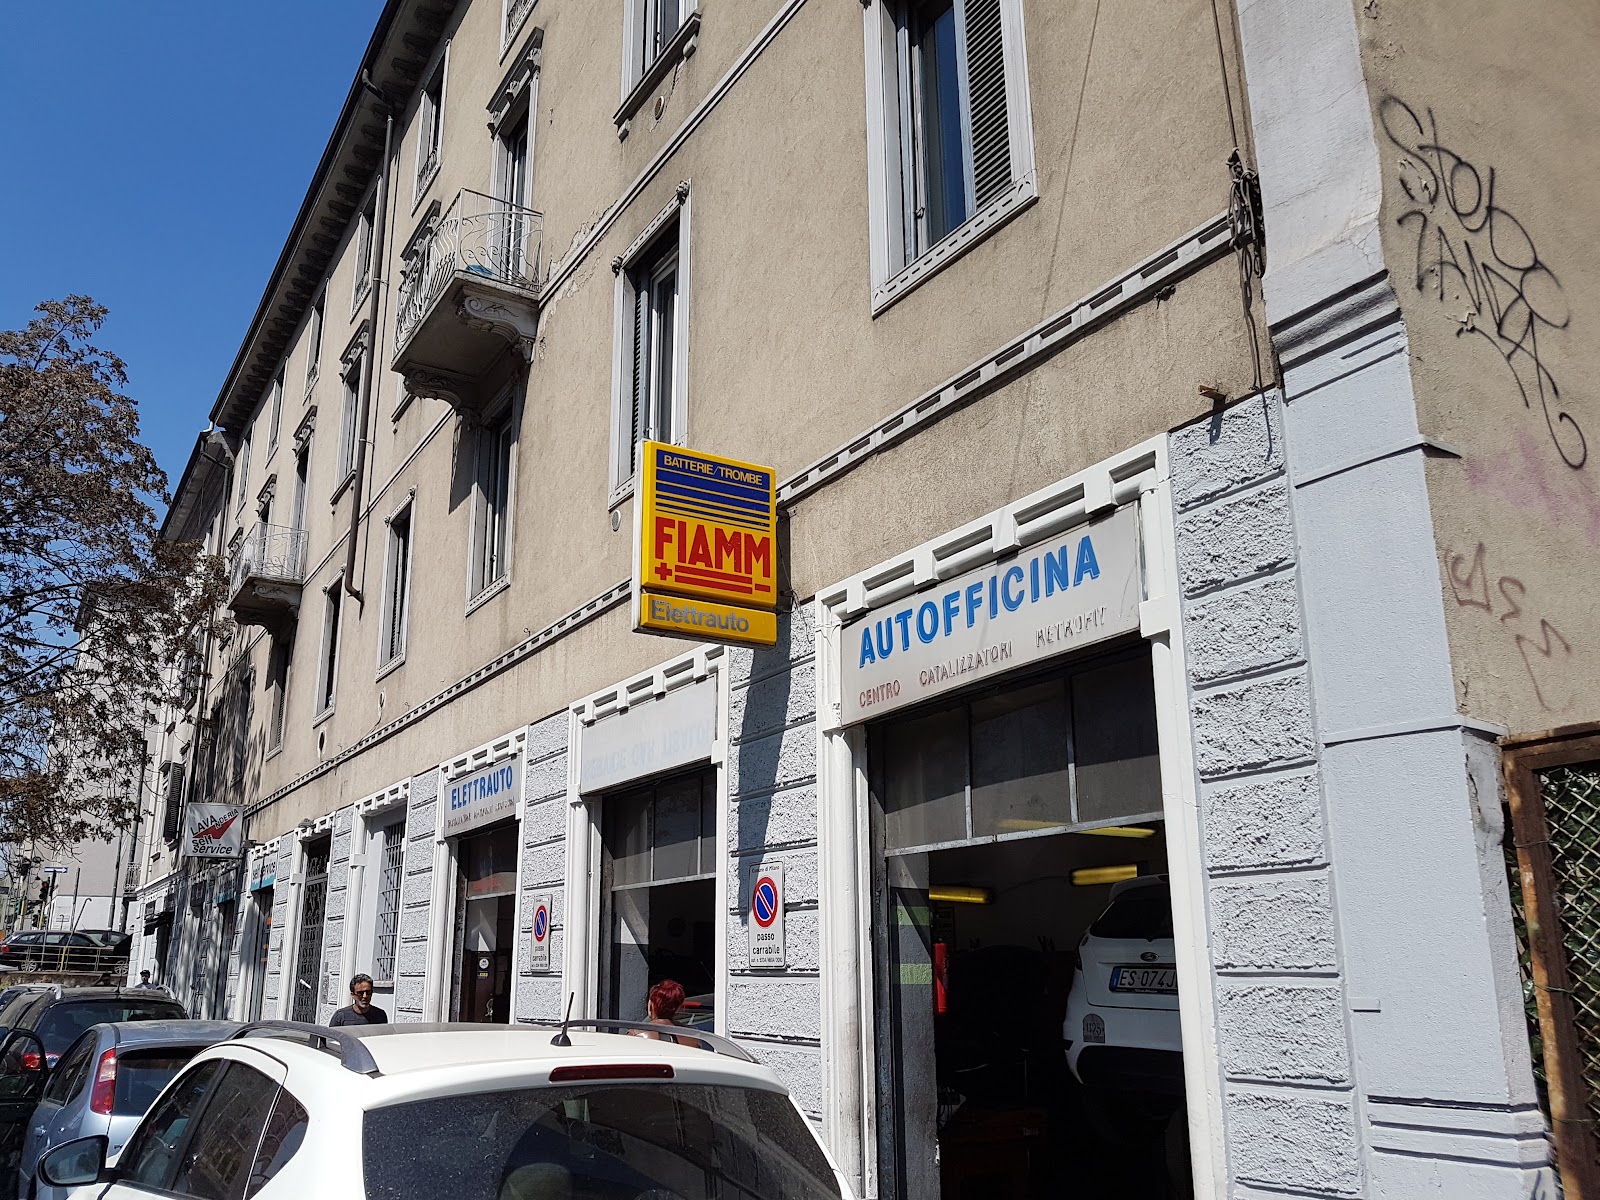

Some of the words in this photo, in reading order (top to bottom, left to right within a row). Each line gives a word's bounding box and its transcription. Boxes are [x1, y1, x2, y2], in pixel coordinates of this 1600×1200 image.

[655, 516, 771, 578] FIAMM
[651, 599, 750, 632] Elettrauto
[859, 535, 1101, 669] AUTOFFICINA
[859, 679, 901, 708] CENTRO
[919, 640, 1013, 688] CATALIZZATORI
[451, 765, 513, 811] ELETTRAUTO
[192, 834, 213, 847] self
[192, 844, 233, 855] service
[752, 944, 780, 955] carrabile
[757, 932, 775, 942] passo
